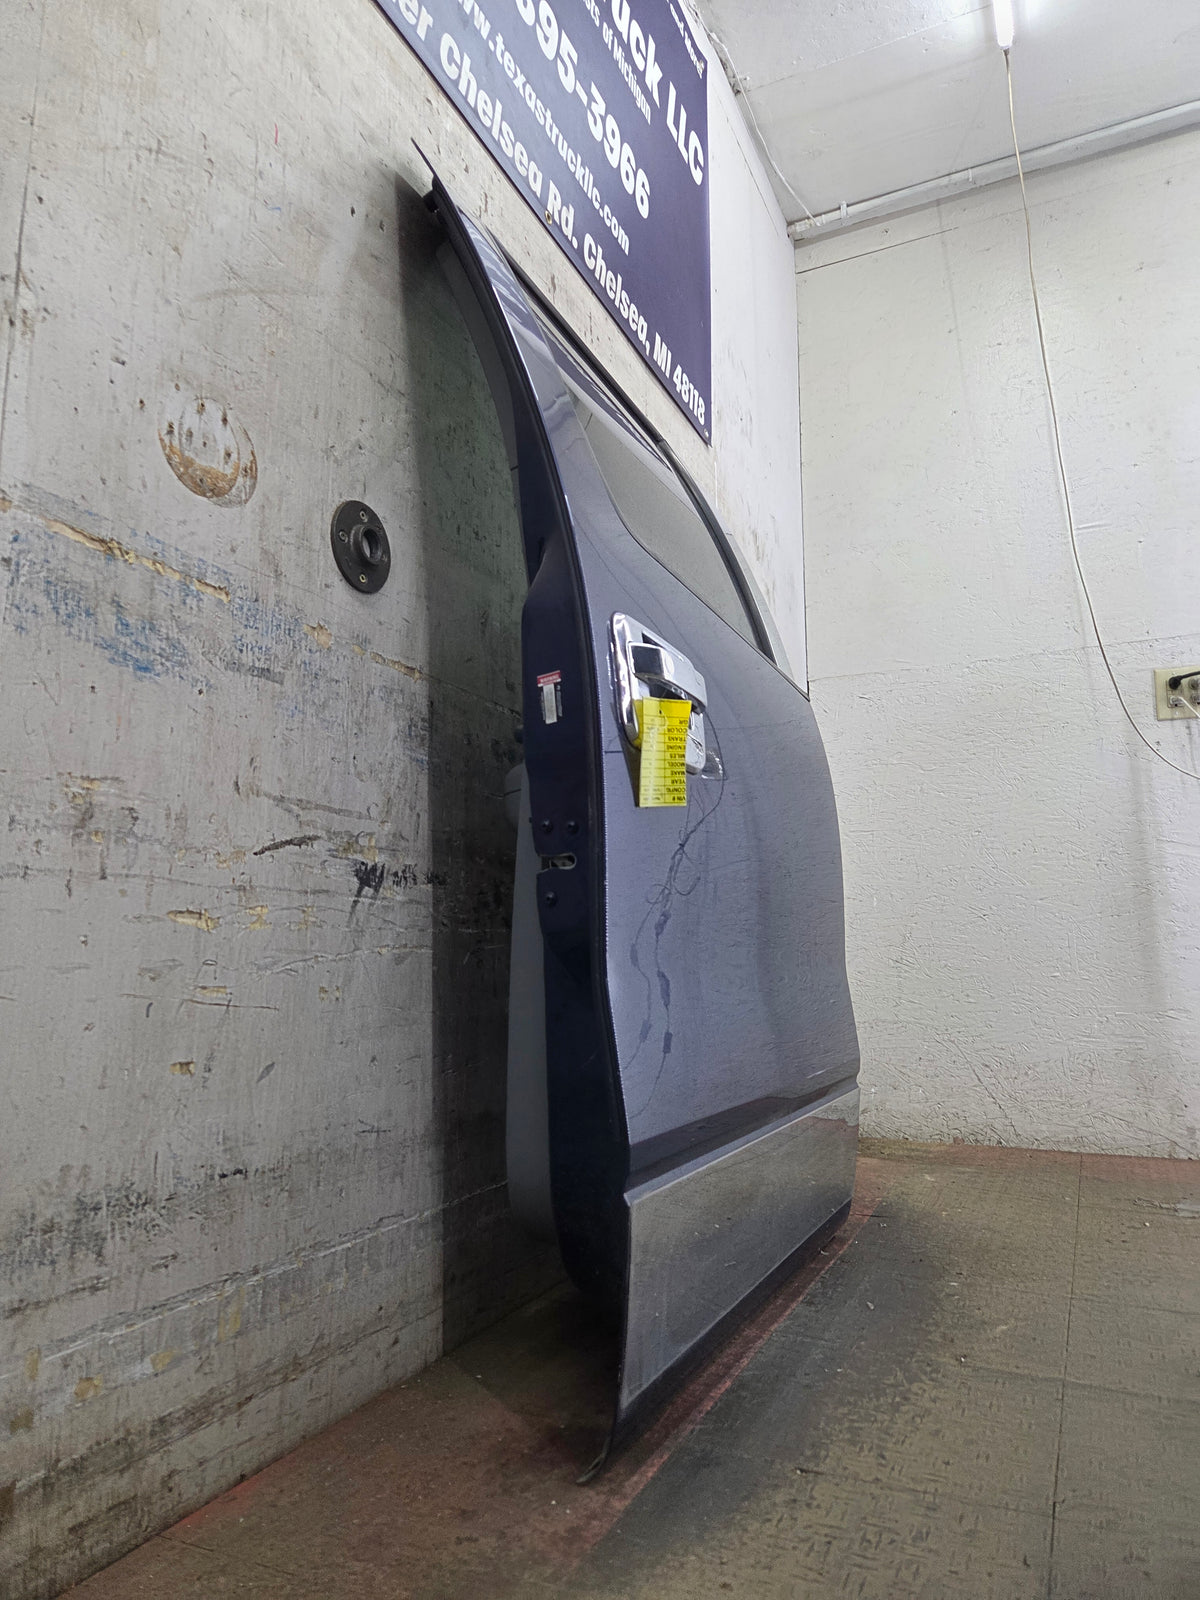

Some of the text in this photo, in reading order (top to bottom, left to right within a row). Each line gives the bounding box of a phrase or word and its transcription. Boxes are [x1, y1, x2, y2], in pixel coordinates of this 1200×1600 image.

[602, 22, 613, 51] of
[613, 36, 651, 125] Michigan
[603, 0, 704, 187] uck LLC
[392, 0, 705, 426] er Chelsea Rd. Chelsea, MI 48118
